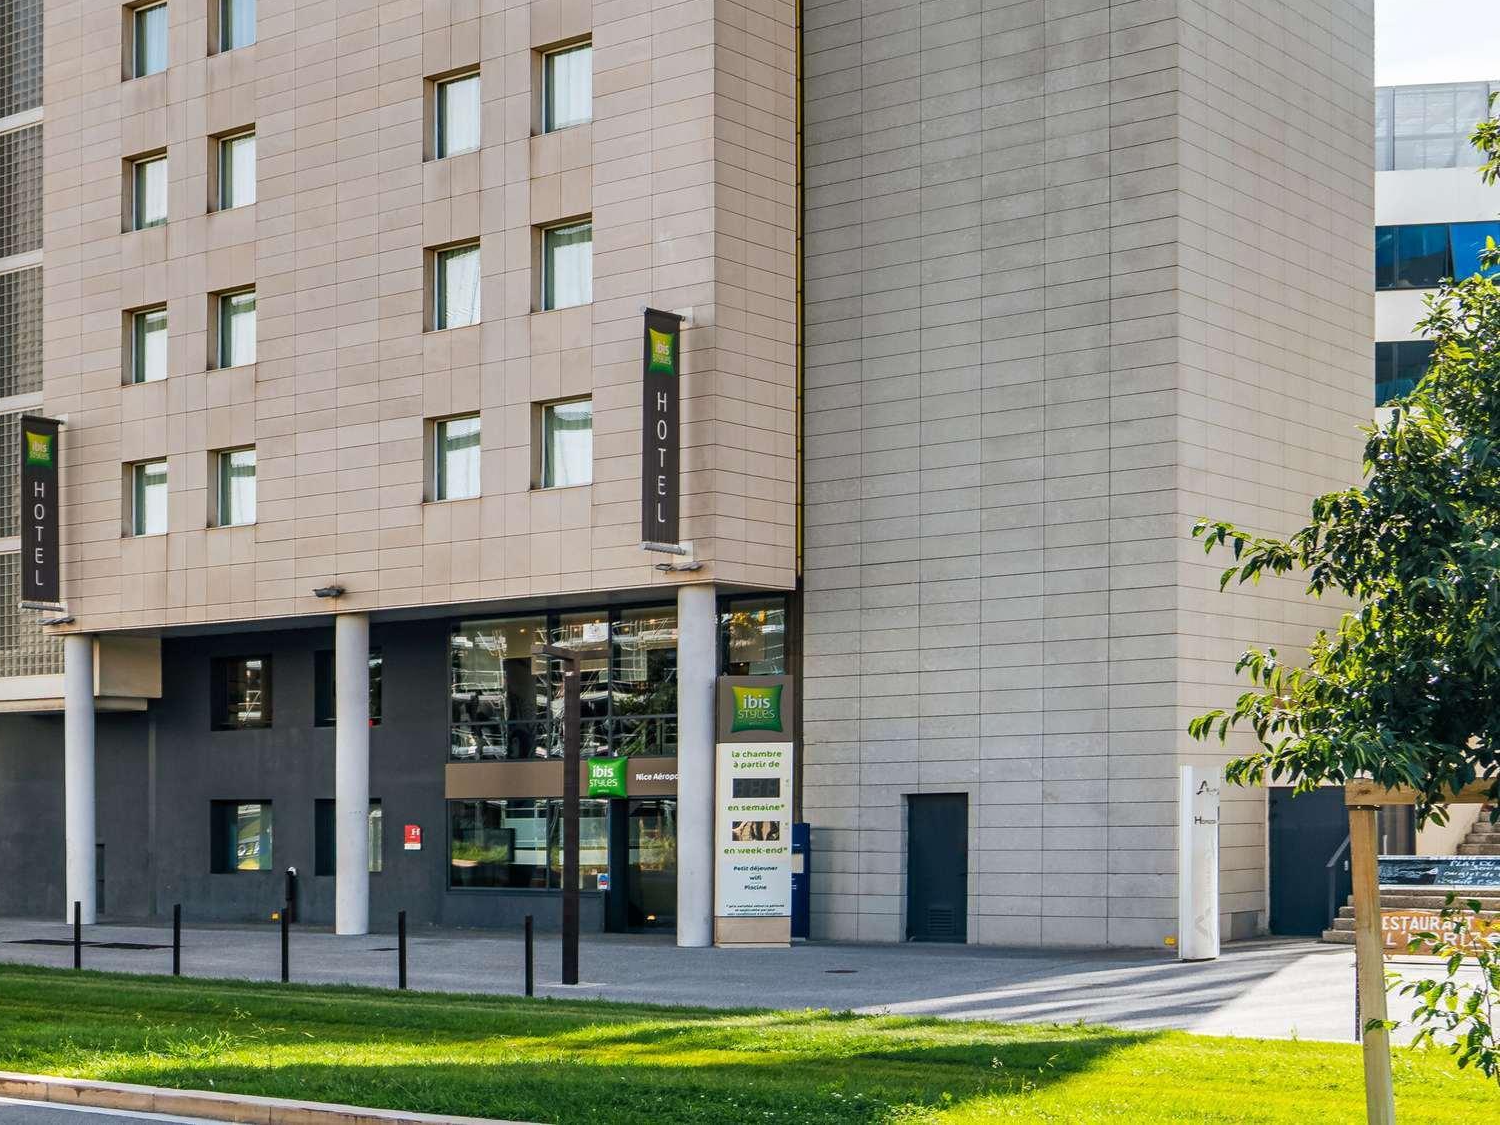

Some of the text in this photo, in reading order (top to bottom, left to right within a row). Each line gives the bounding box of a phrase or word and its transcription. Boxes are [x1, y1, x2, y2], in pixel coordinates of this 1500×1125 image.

[656, 391, 668, 523] HOTEL
[33, 481, 45, 586] HOTEL
[743, 694, 771, 709] ibis
[731, 750, 782, 758] la chambre
[592, 765, 614, 778] ibis
[740, 761, 766, 769] partir
[635, 772, 680, 781] Nice Aéropo
[1381, 915, 1475, 930] ESTAURANT
